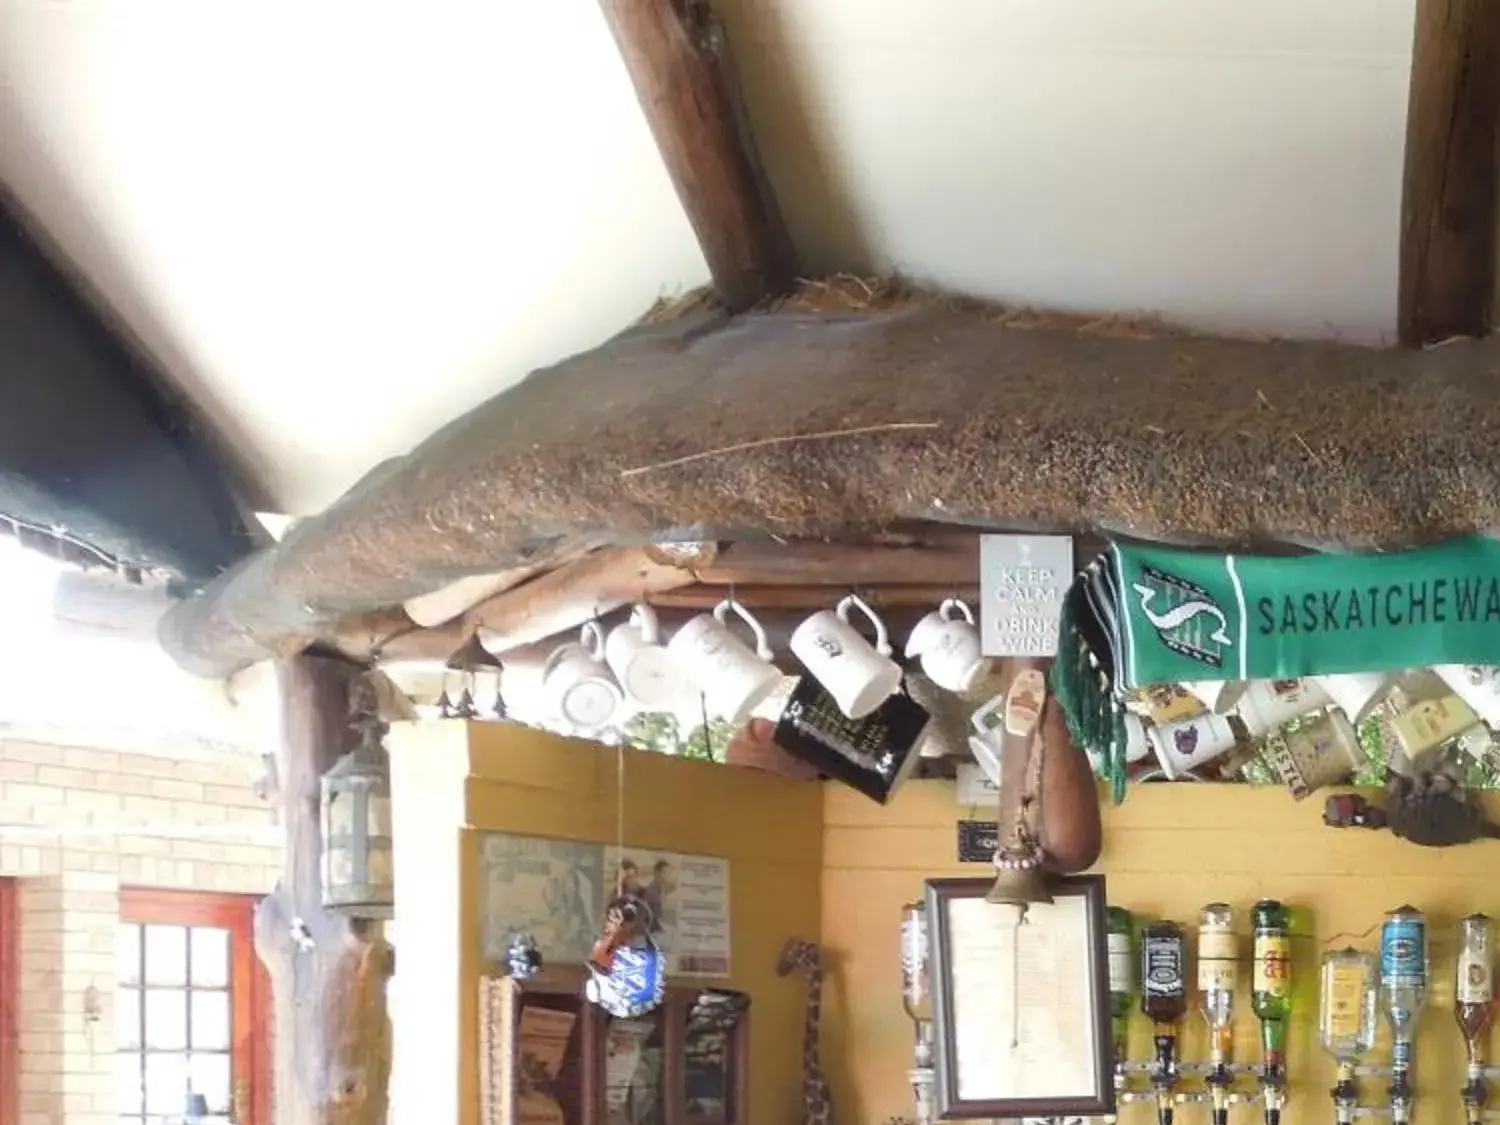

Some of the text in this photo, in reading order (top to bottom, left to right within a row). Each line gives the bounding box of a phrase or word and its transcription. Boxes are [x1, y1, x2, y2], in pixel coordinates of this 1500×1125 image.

[1001, 567, 1054, 585] KEEP
[994, 586, 1058, 603] CALM
[994, 616, 1059, 635] DRINK
[1000, 636, 1054, 654] WINE
